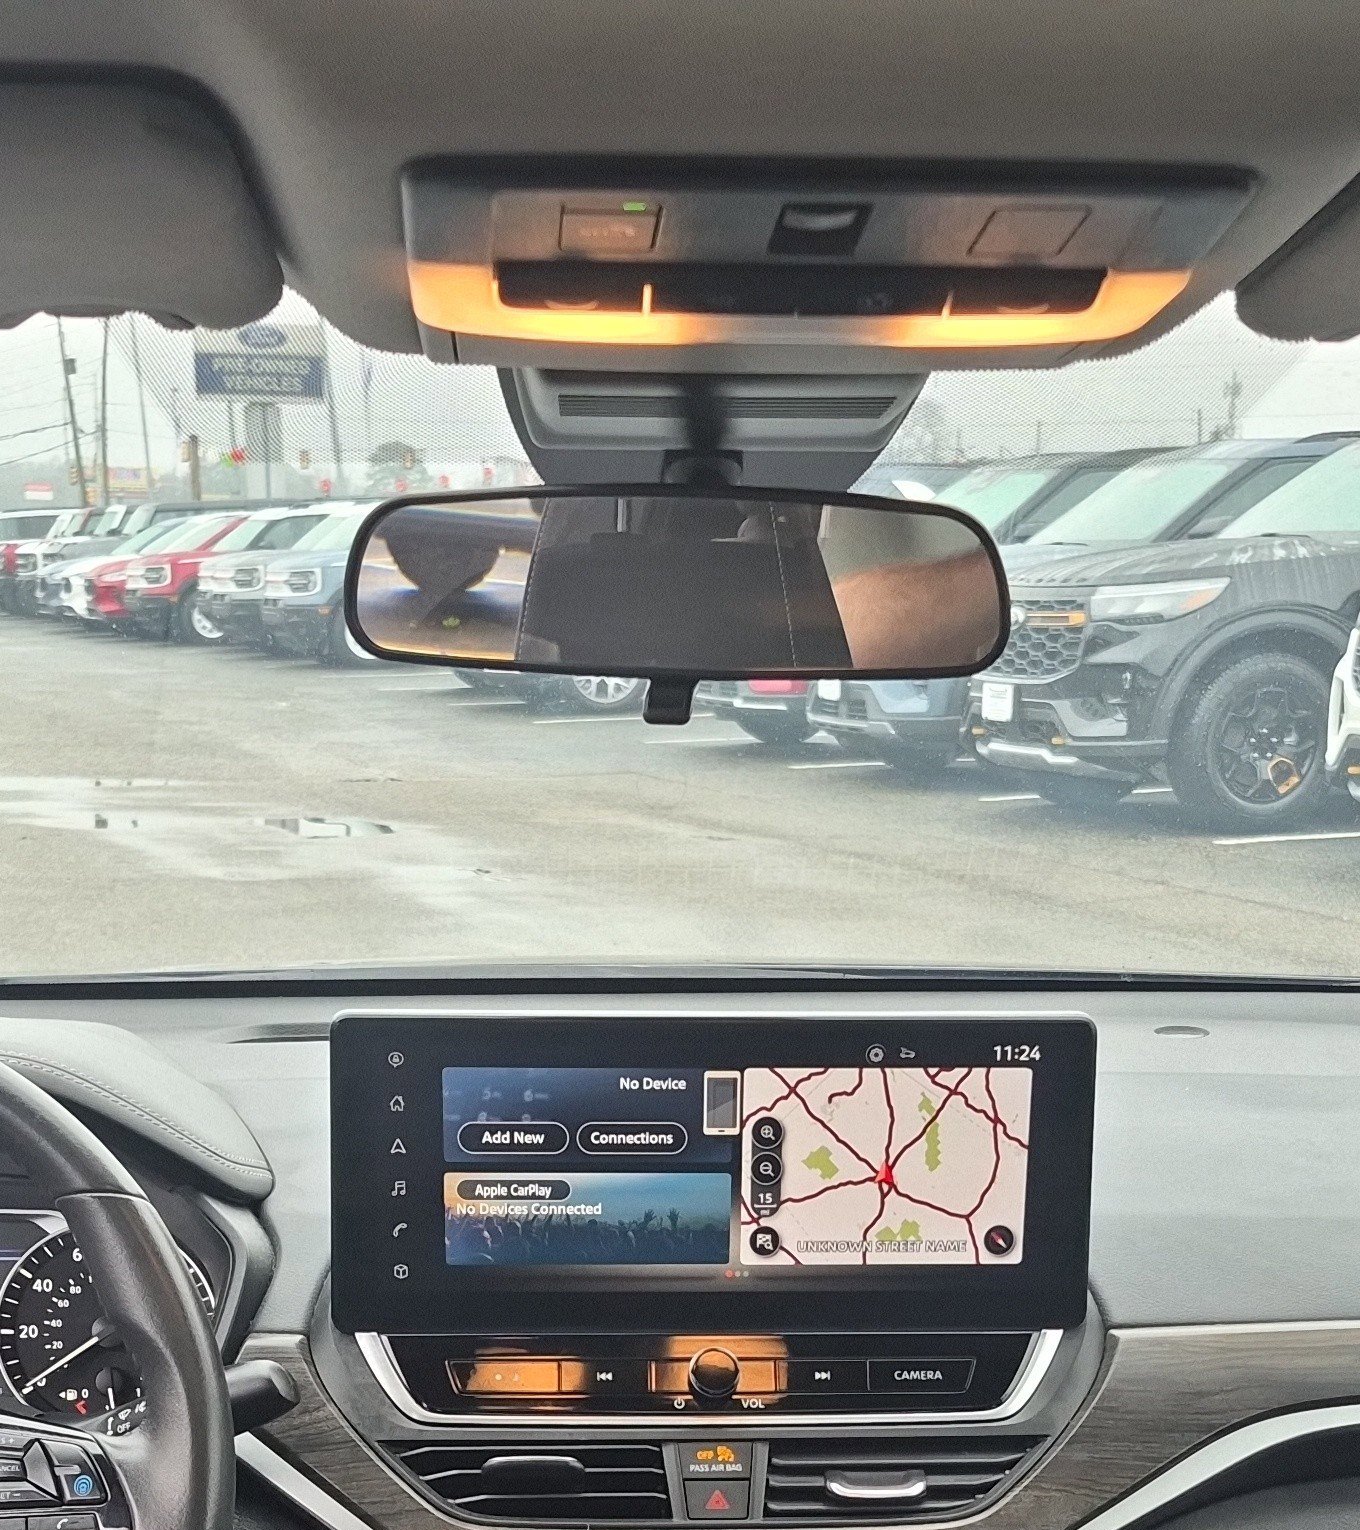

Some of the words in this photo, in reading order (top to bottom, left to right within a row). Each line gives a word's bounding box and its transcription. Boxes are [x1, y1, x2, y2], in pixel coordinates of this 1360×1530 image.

[993, 1044, 1041, 1061] 11:24
[619, 1077, 640, 1090] No
[643, 1077, 687, 1090] Device
[481, 1131, 511, 1144] Add
[513, 1131, 545, 1144] New
[590, 1131, 674, 1144] Connections
[474, 1183, 508, 1198] Apple
[510, 1183, 552, 1198] CarPlay
[758, 1192, 773, 1203] 15
[456, 1203, 476, 1214] No
[479, 1203, 528, 1214] Devices
[531, 1203, 602, 1215] Connected
[796, 1240, 872, 1252] UNKNOWN
[875, 1240, 923, 1252] STREET
[925, 1240, 967, 1252] NAME
[32, 1279, 53, 1293] 40
[69, 1285, 82, 1295] 80
[57, 1299, 70, 1308] 60
[50, 1319, 63, 1328] 40
[18, 1325, 39, 1339] 20
[51, 1341, 64, 1349] 20
[894, 1369, 943, 1381] CAMERA
[80, 1388, 89, 1398] 0
[742, 1398, 765, 1410] VOL
[117, 1421, 131, 1434] OFF
[696, 1450, 715, 1461] OFF
[690, 1464, 710, 1472] PASS
[711, 1464, 725, 1472] AIR
[726, 1464, 743, 1472] BAG
